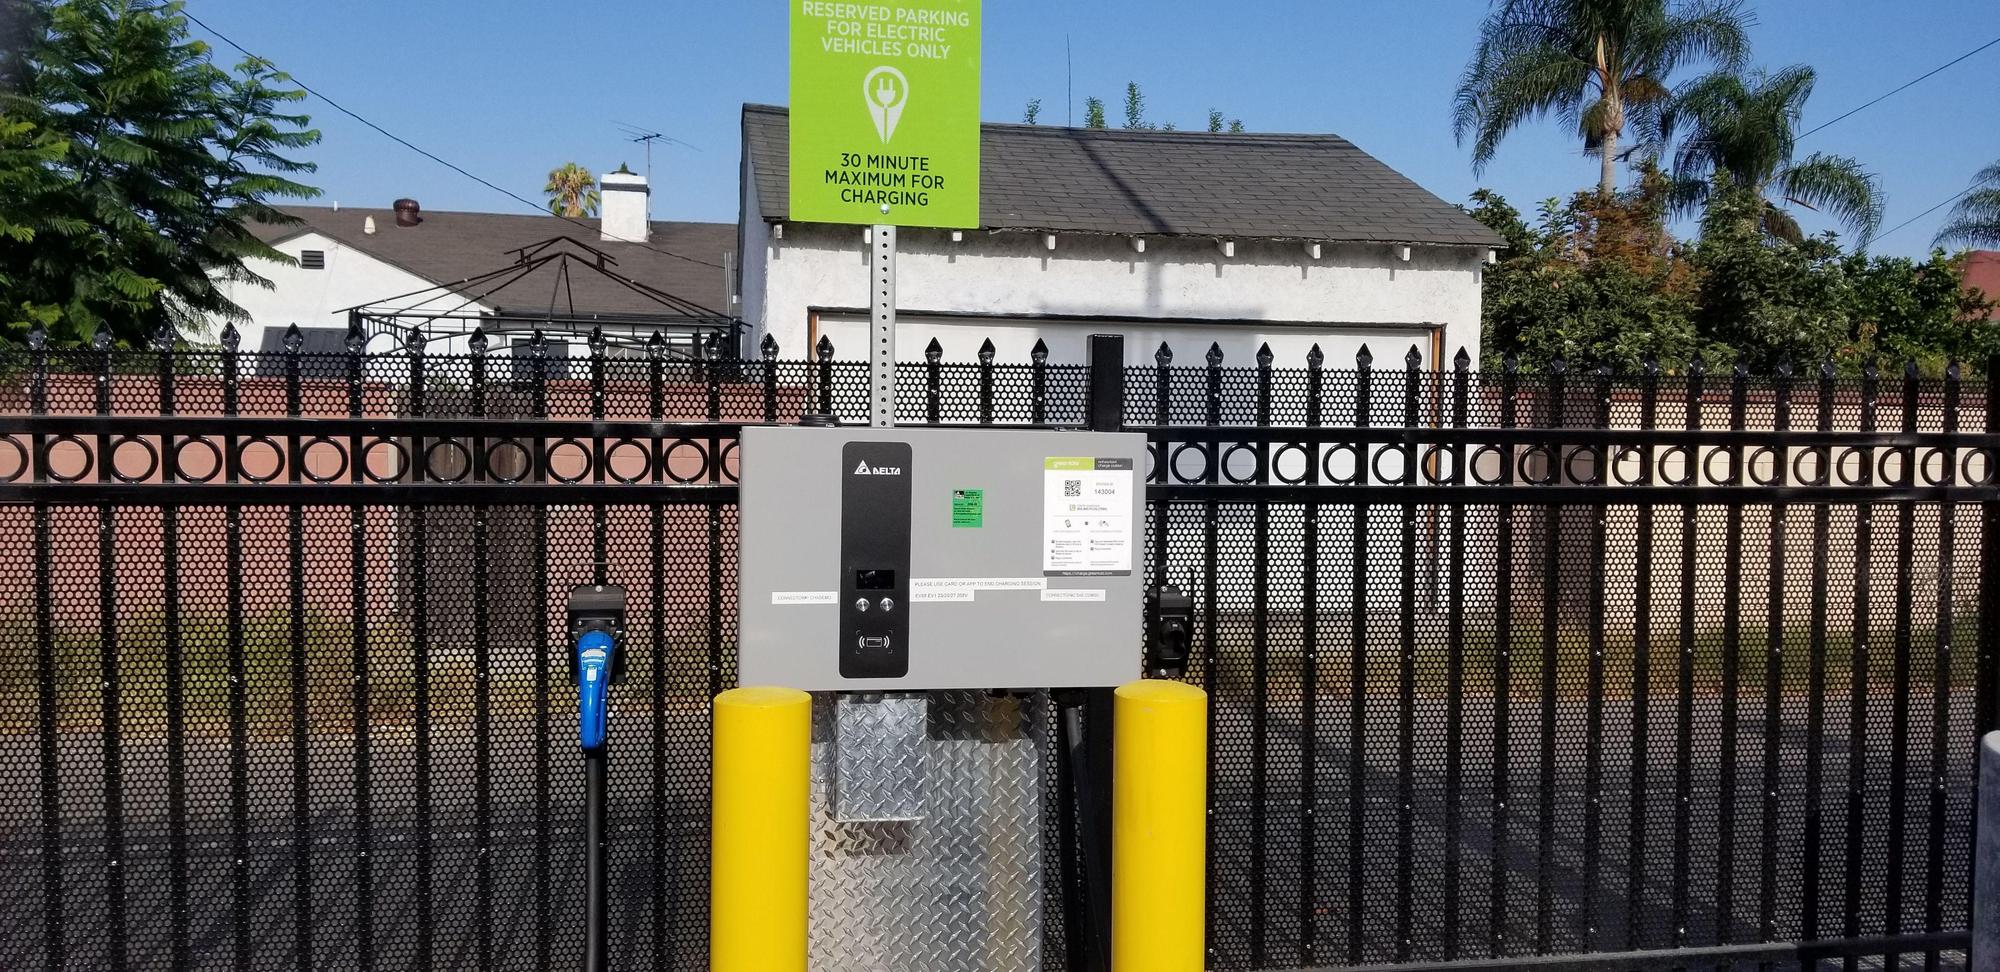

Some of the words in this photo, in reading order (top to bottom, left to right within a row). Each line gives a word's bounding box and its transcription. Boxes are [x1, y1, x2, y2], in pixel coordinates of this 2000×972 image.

[802, 1, 891, 22] RESERVED
[896, 9, 969, 27] PARKING
[827, 20, 862, 37] FOR
[867, 23, 945, 42] ELECTRIC
[821, 37, 901, 56] VEHICLES
[907, 43, 950, 59] ONLY
[841, 153, 861, 168] 30
[867, 154, 929, 171] MINUTE
[825, 170, 905, 188] MAXIMUM
[911, 174, 945, 190] FOR
[841, 189, 928, 206] CHARGING
[872, 467, 901, 475] DELTA
